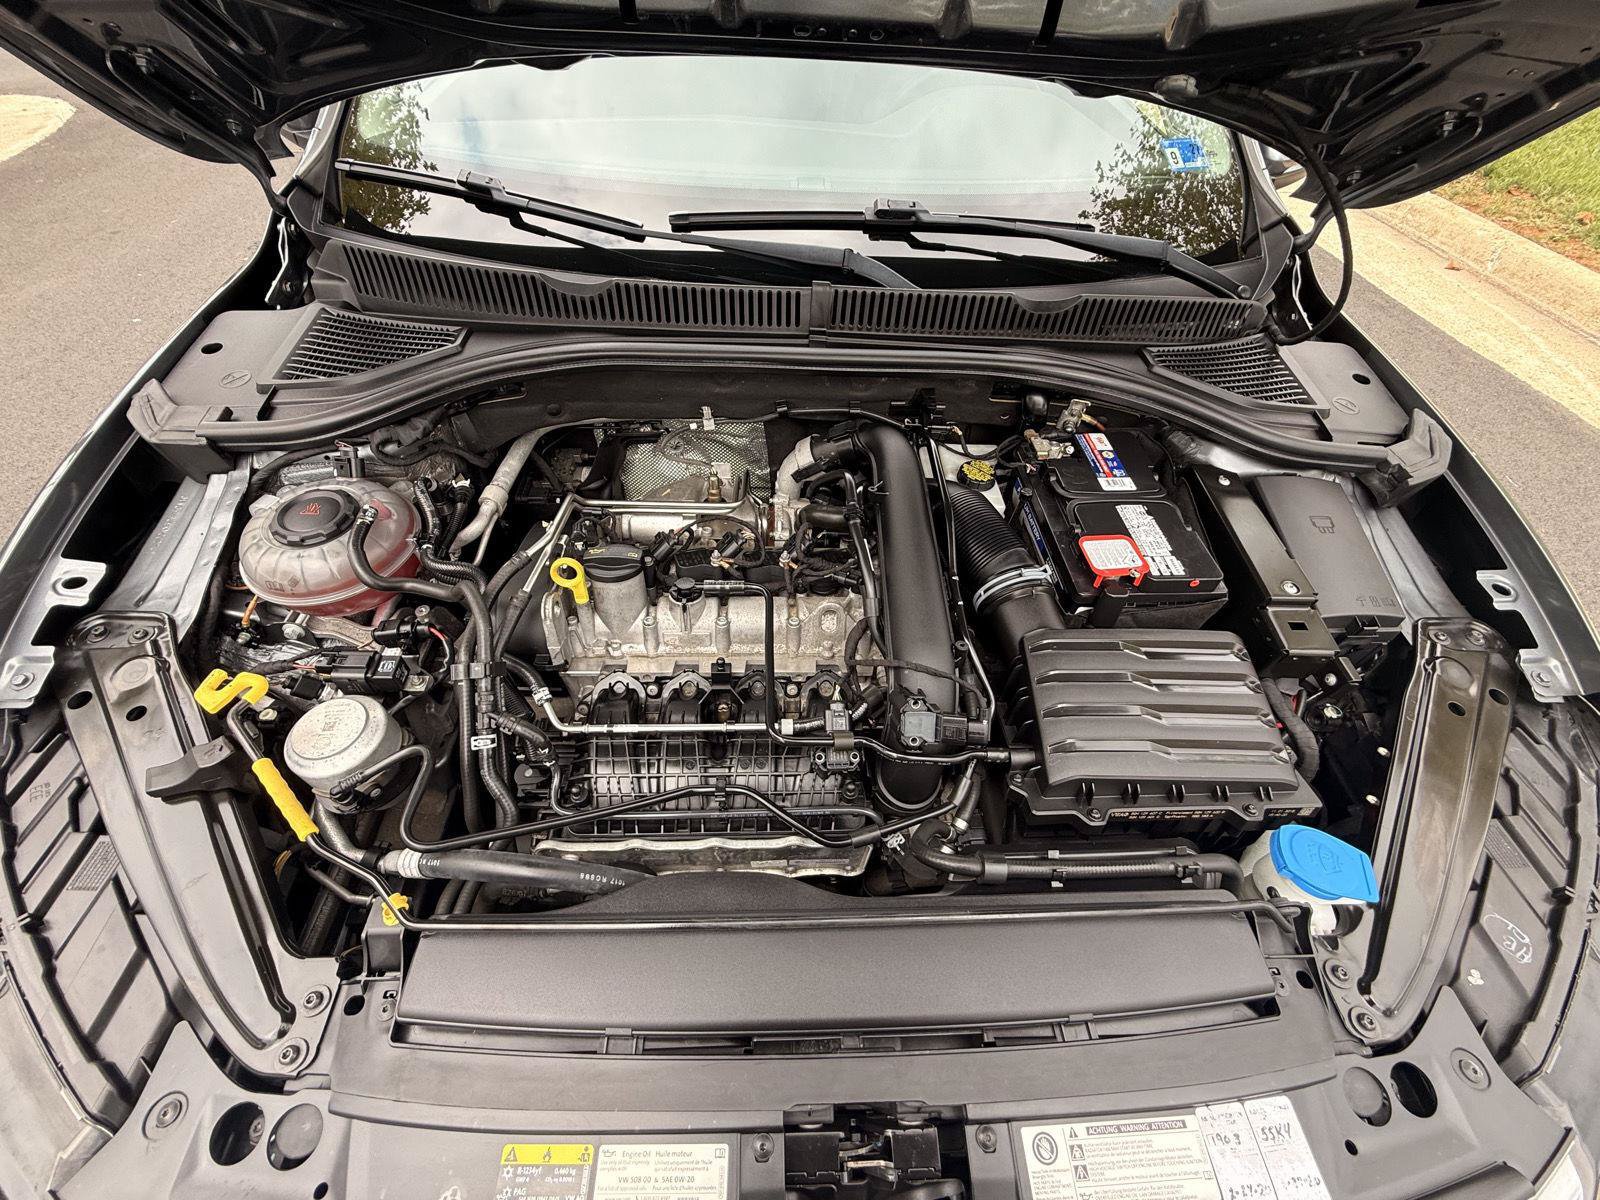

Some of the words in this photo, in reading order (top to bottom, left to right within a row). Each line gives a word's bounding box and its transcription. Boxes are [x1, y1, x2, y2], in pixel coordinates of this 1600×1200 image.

[1170, 151, 1179, 165] 9
[1088, 1125, 1119, 1135] ACHTUNG
[1120, 1123, 1149, 1133] WARNING
[1150, 1120, 1184, 1130] ATTENTION
[622, 1150, 642, 1159] Engine
